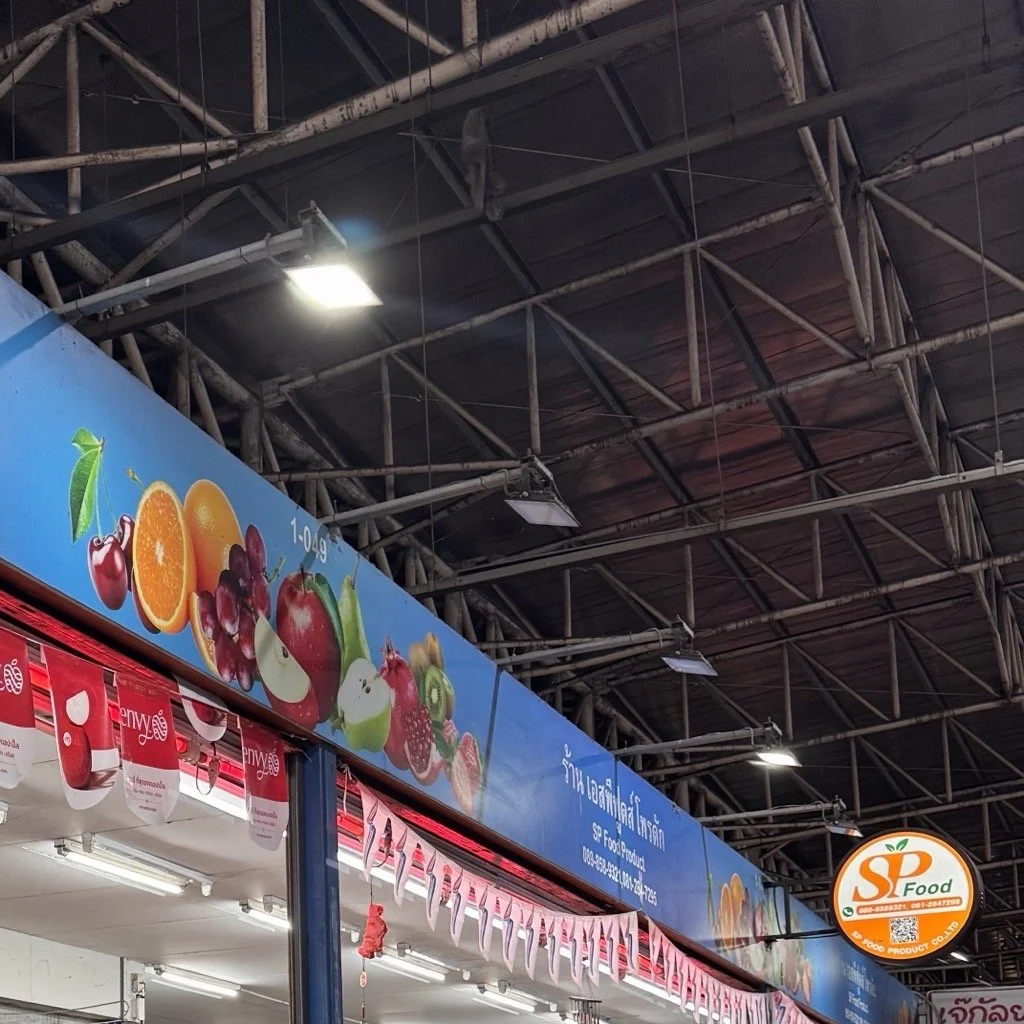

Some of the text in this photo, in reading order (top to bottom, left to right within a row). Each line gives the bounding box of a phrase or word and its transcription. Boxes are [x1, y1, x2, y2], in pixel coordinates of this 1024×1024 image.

[120, 704, 154, 747] envy
[242, 746, 269, 781] envy
[592, 822, 603, 843] SP
[621, 840, 646, 873] Product
[852, 850, 953, 903] SP Food
[862, 939, 885, 952] FOOD
[887, 943, 929, 955] PRODUCT
